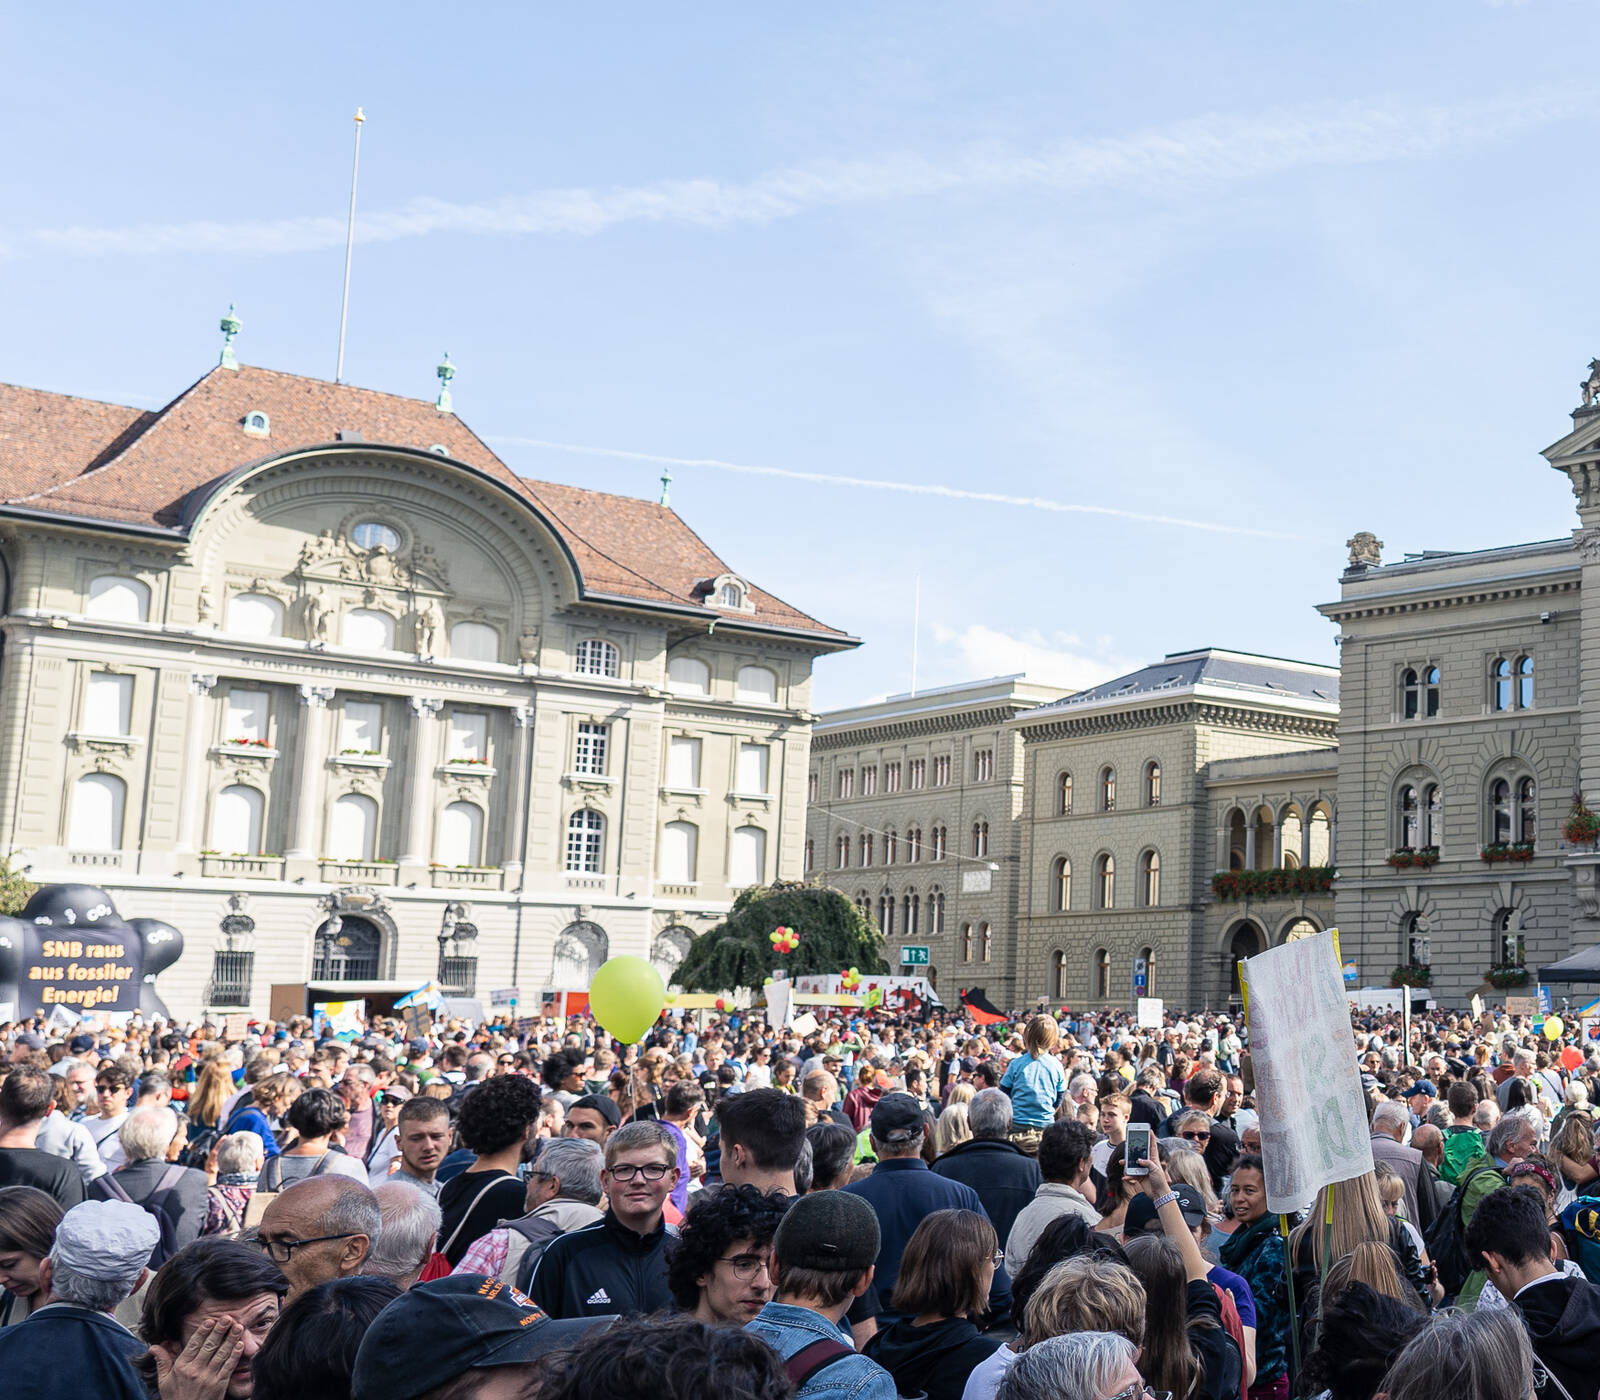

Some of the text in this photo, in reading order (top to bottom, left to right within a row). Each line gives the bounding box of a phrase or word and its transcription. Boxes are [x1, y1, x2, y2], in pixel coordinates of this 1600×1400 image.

[42, 940, 125, 958] SNB raus
[28, 966, 65, 981] aus
[66, 962, 134, 981] fossiler
[42, 984, 121, 1008] Energie!
[587, 1296, 612, 1305] adidas
